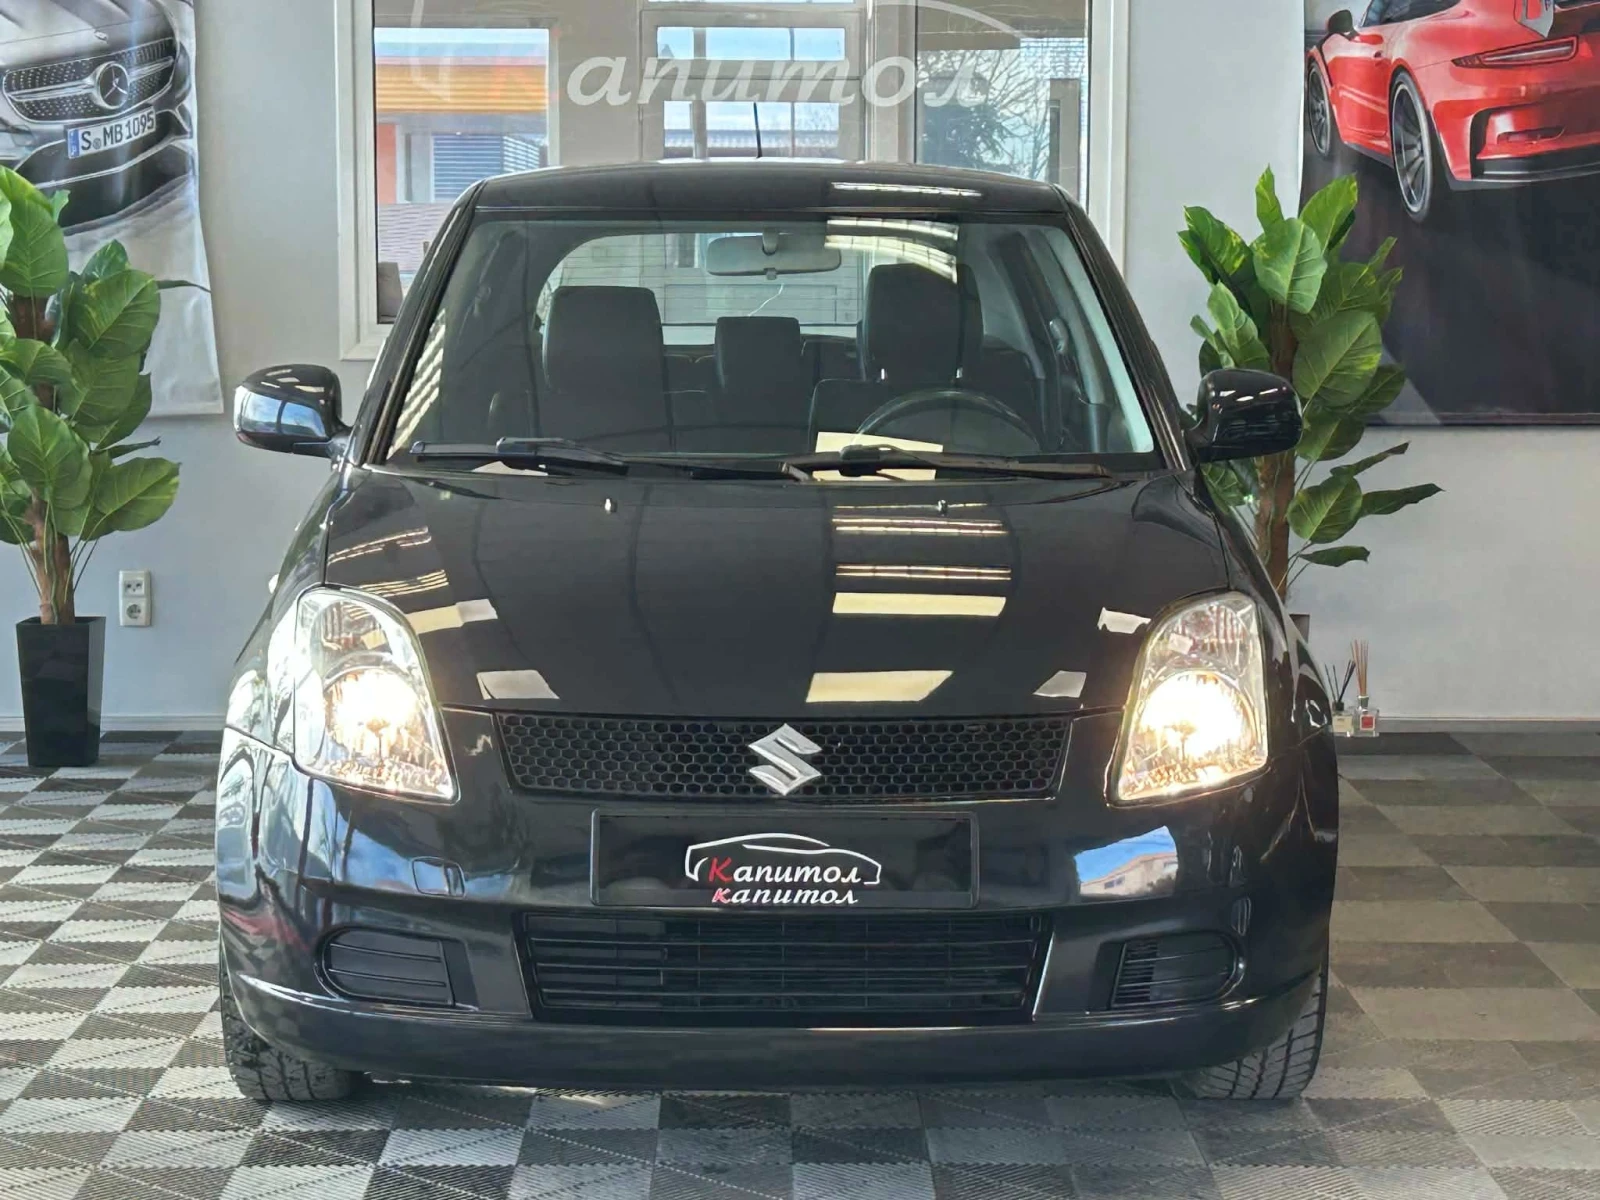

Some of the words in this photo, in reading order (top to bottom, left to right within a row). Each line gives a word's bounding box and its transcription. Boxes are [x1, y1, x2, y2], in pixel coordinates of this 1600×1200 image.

[81, 130, 92, 151] S
[103, 124, 123, 147] MB
[125, 110, 155, 140] 1095
[708, 856, 862, 883] Капитол
